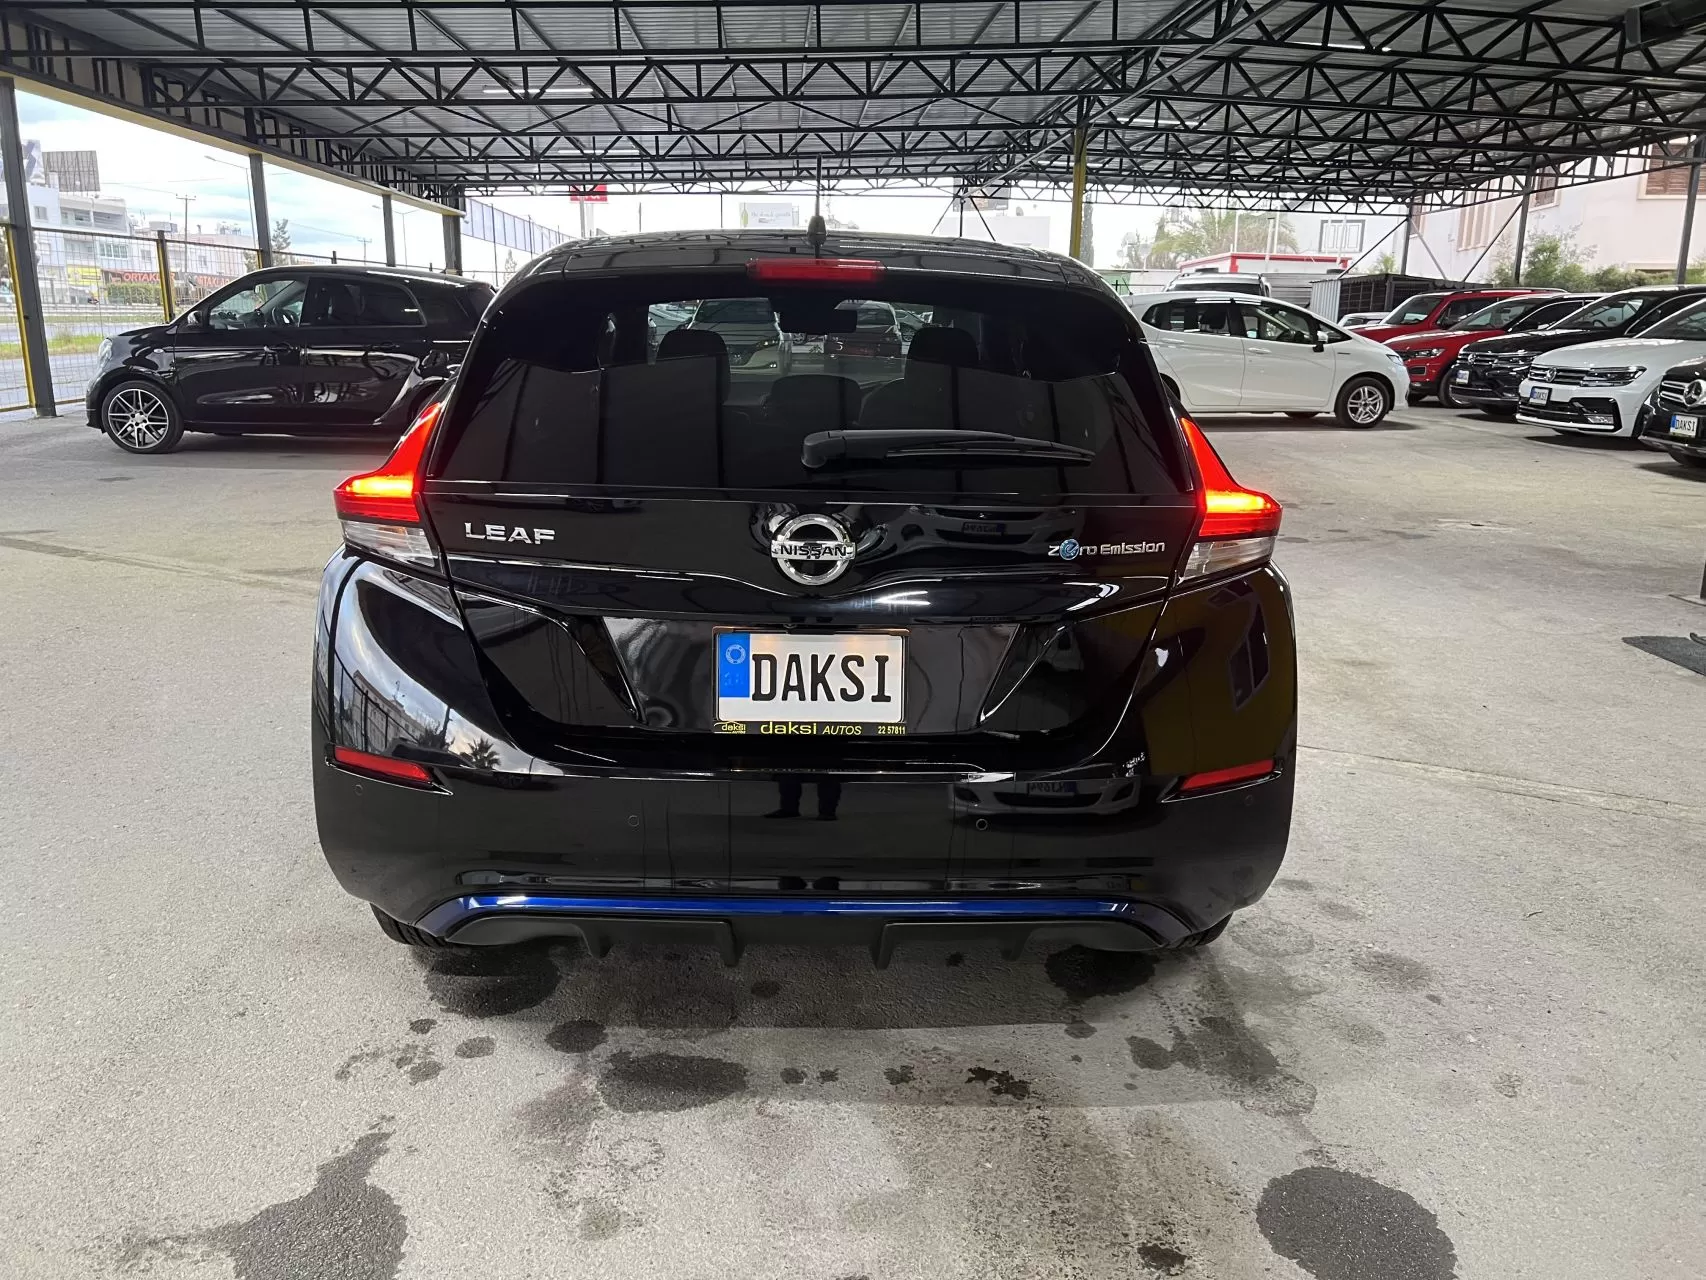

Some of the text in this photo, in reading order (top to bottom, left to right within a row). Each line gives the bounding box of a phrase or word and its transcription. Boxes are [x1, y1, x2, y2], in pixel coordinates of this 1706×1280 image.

[123, 271, 176, 283] ORTAKLR
[1675, 419, 1696, 431] DAKSI
[464, 522, 556, 545] LEAF
[780, 543, 847, 557] NISSAN
[1100, 541, 1165, 555] Emission
[751, 653, 892, 703] DAKSI
[760, 721, 817, 735] daksi
[822, 725, 863, 736] AUTOS
